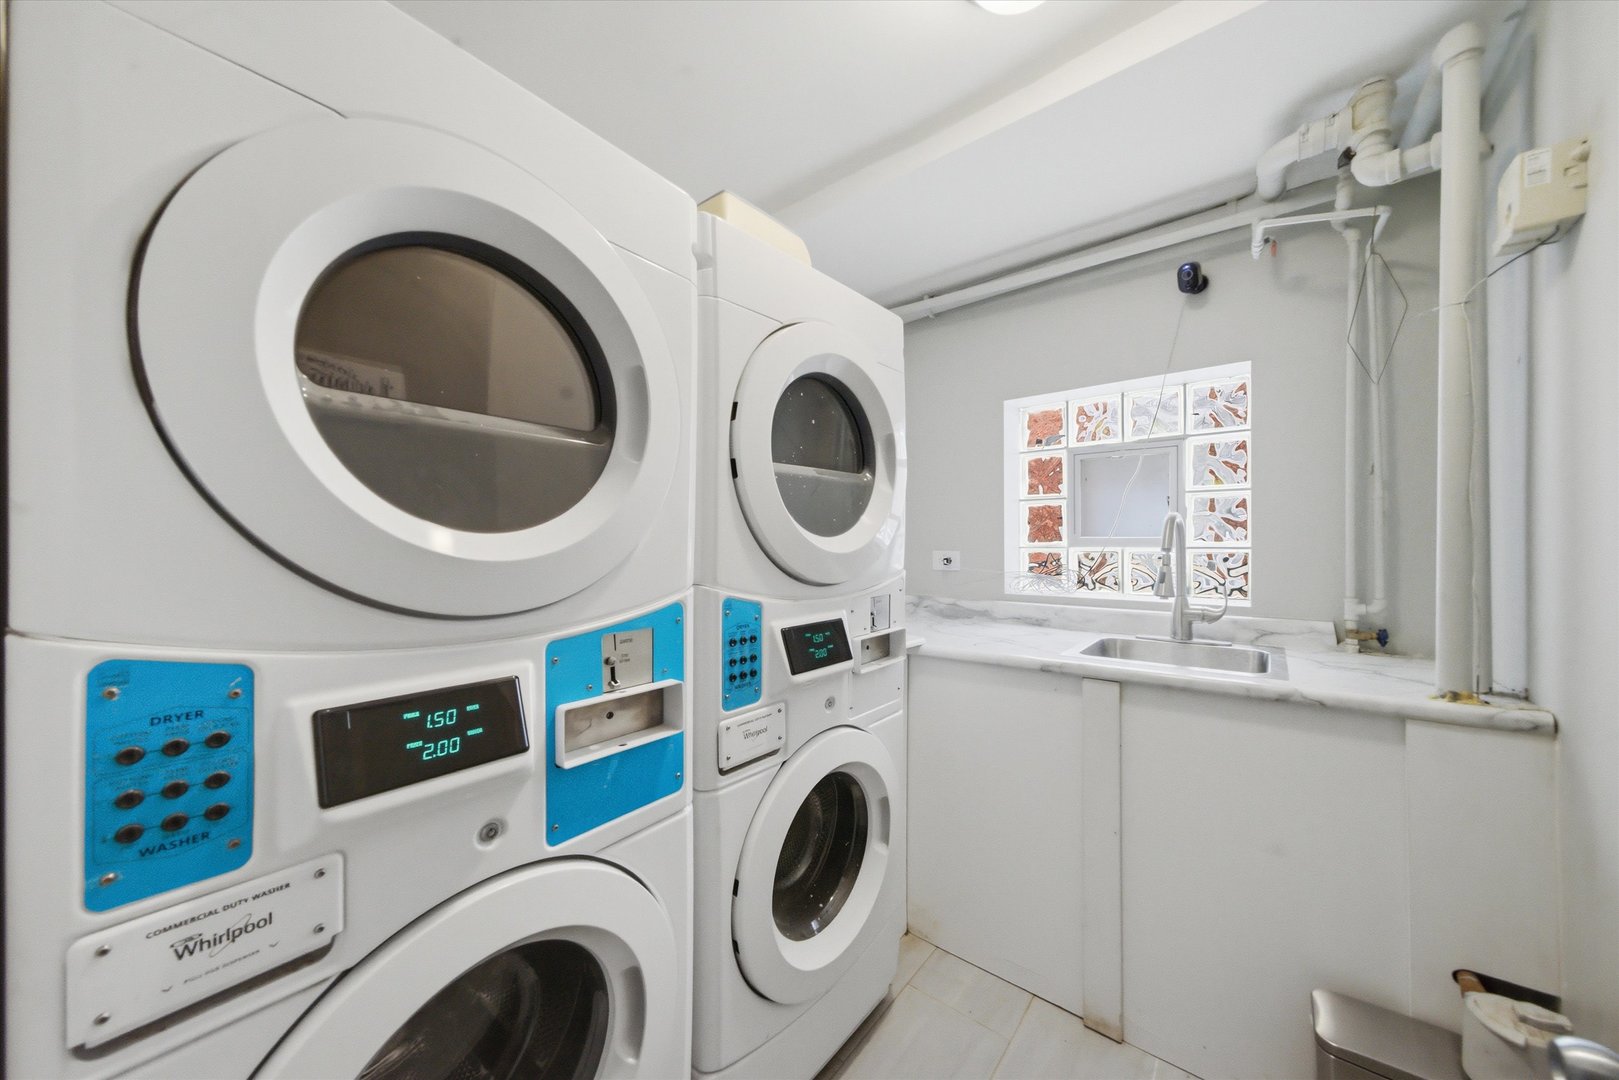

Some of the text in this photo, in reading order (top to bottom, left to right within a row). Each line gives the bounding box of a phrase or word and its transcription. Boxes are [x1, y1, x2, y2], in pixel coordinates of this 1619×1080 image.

[149, 709, 205, 727] DRYER
[426, 708, 457, 728] 1.50
[423, 736, 460, 760] 2.00
[139, 831, 210, 857] WASHER
[145, 882, 291, 940] COMMERCIAL DUTY WASHER
[173, 911, 273, 962] Whirlpool
